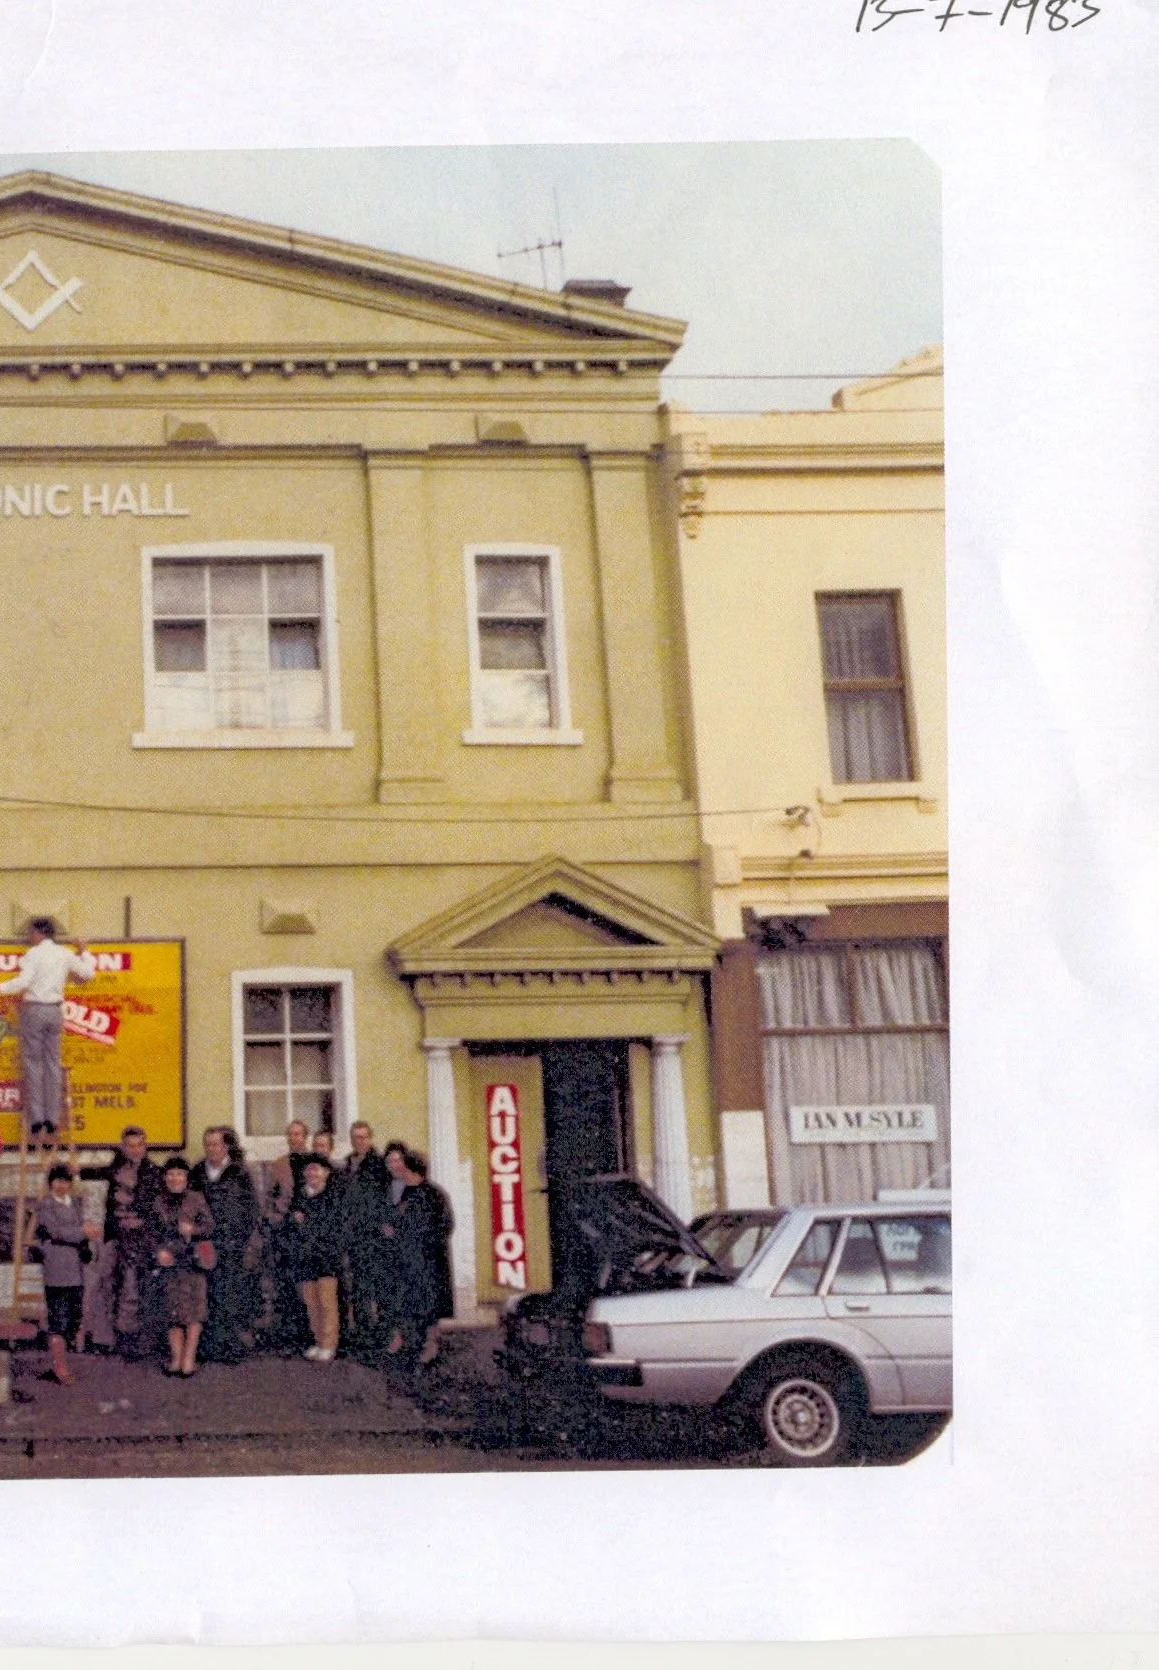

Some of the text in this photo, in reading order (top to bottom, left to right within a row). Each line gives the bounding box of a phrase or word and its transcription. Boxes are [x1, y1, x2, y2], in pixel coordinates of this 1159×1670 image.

[82, 483, 189, 517] HALL
[60, 999, 111, 1035] OLD
[803, 1111, 838, 1129] IAN
[490, 1085, 526, 1289] AUCTION
